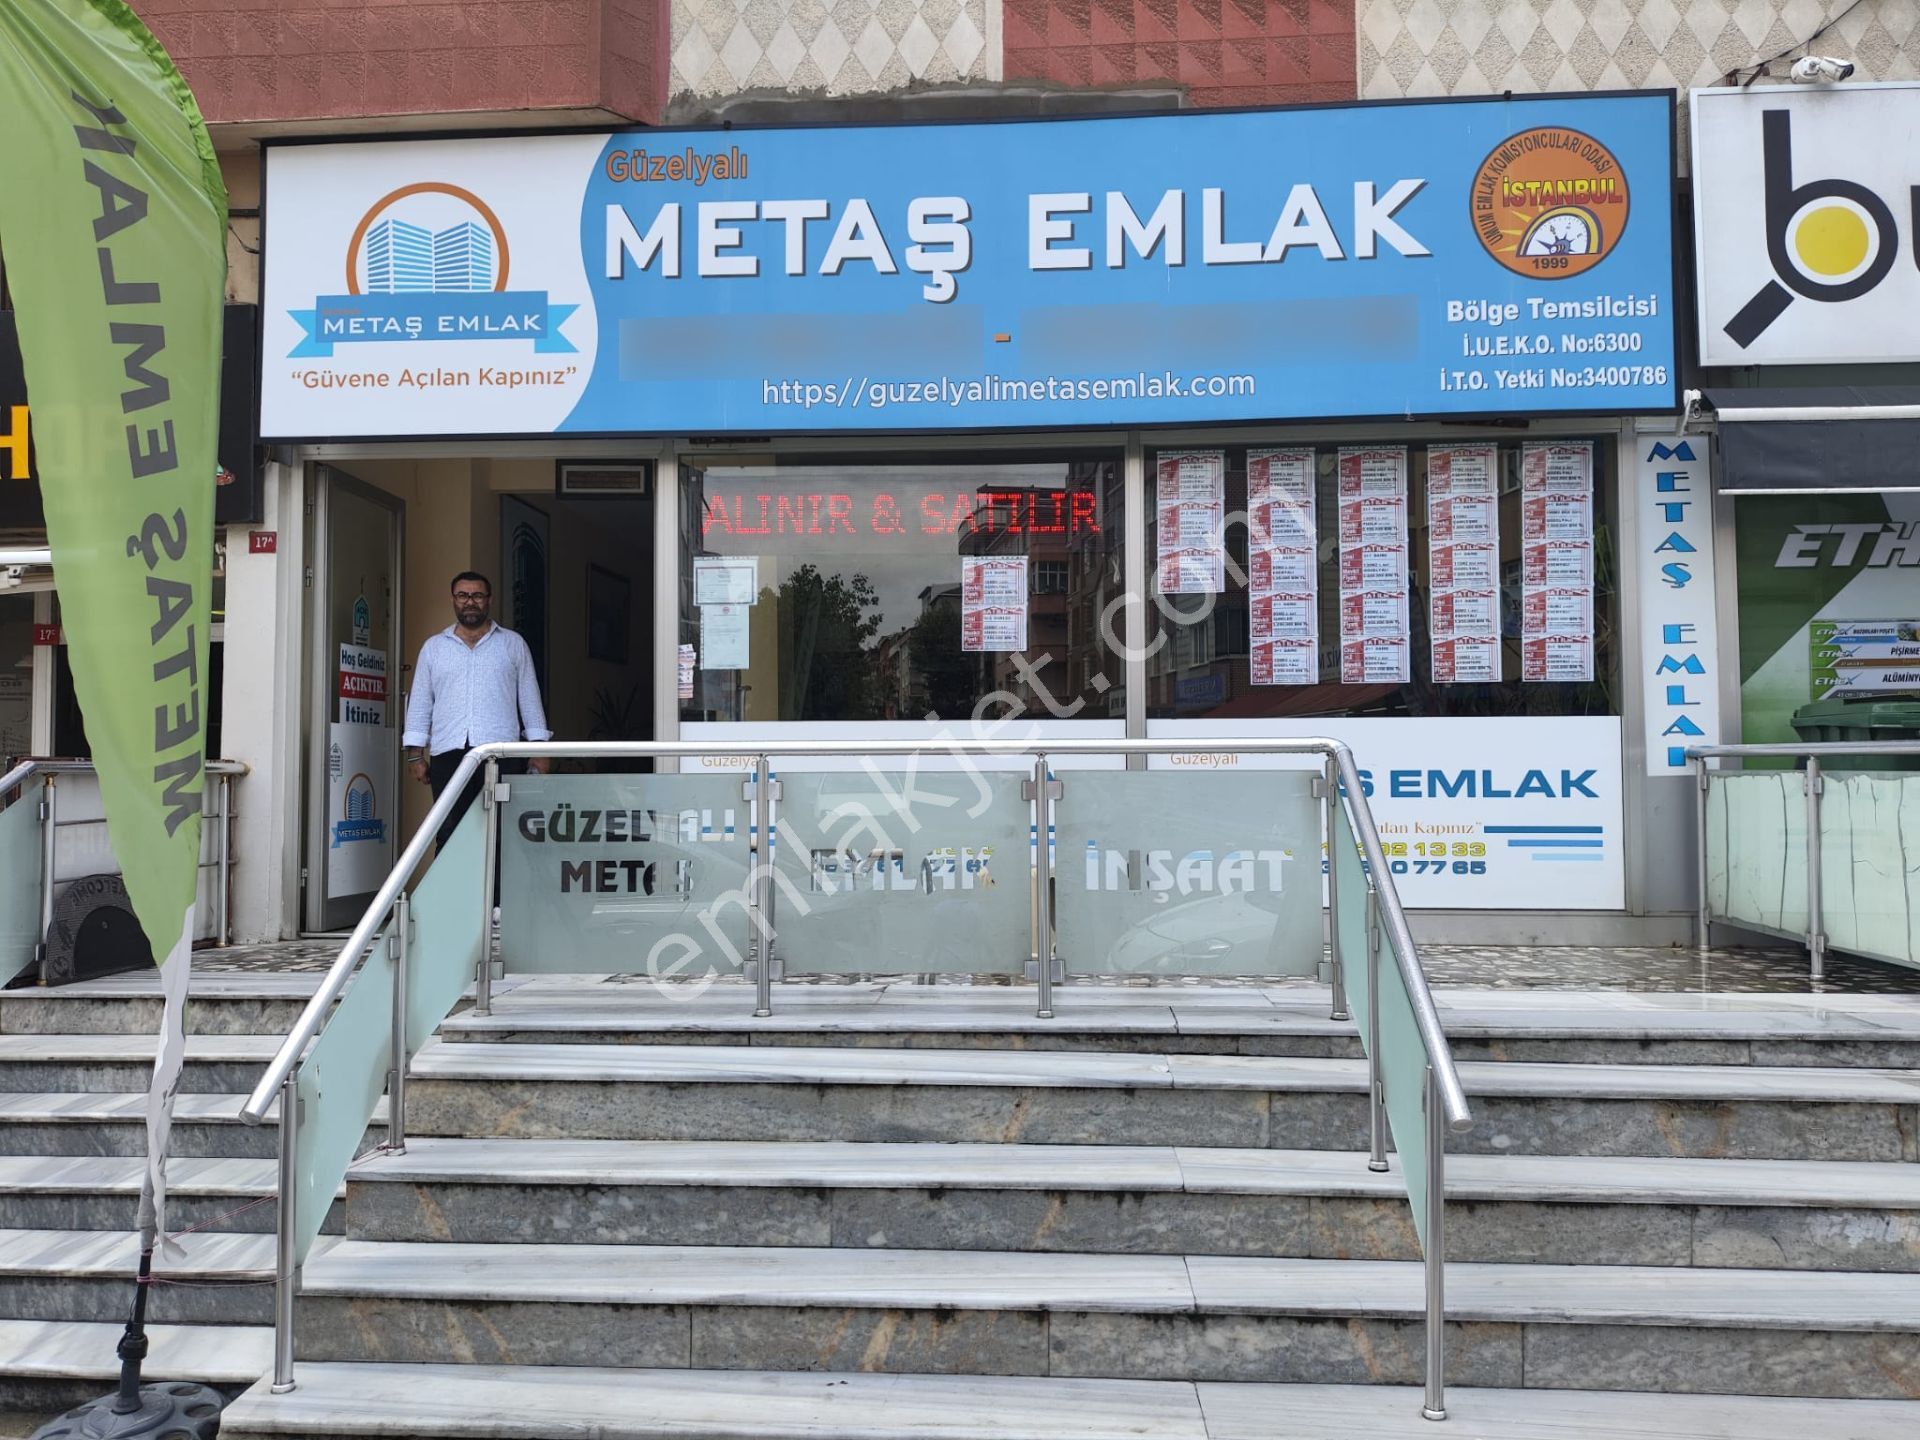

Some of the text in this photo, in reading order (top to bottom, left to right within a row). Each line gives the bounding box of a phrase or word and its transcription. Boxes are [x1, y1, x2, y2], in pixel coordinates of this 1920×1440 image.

[605, 146, 749, 186] Güzelyalı
[1477, 173, 1499, 211] EMLAK
[1580, 143, 1613, 175] ODASI
[1502, 176, 1624, 208] İSTANBUL
[605, 177, 1433, 304] METAŞ EMLAK
[1532, 256, 1569, 269] 1999
[1447, 294, 1657, 326] Bölge Temsilcisi
[324, 313, 542, 338] METAŞ EMLAK
[1463, 332, 1642, 357] İ.U.E.K.O. No:6300
[397, 367, 470, 389] Açılan
[762, 370, 1256, 410] https//guzelyalimetasemlak.com
[1440, 366, 1667, 391] İ.T.O. Yetki No:3400786
[702, 491, 1101, 536] ALINIR & SATILIR
[1646, 440, 1698, 589] METAŞ
[341, 649, 385, 672] Hoş Geldiniz
[343, 675, 384, 695] AÇIKTIR
[345, 700, 381, 725] İtiniz
[1390, 769, 1600, 798] EMLAK
[1414, 842, 1447, 856] 13
[1451, 842, 1486, 857] 33
[1085, 838, 1294, 904] İNŞAAT
[1412, 860, 1447, 875] 77
[1451, 860, 1487, 875] 65
